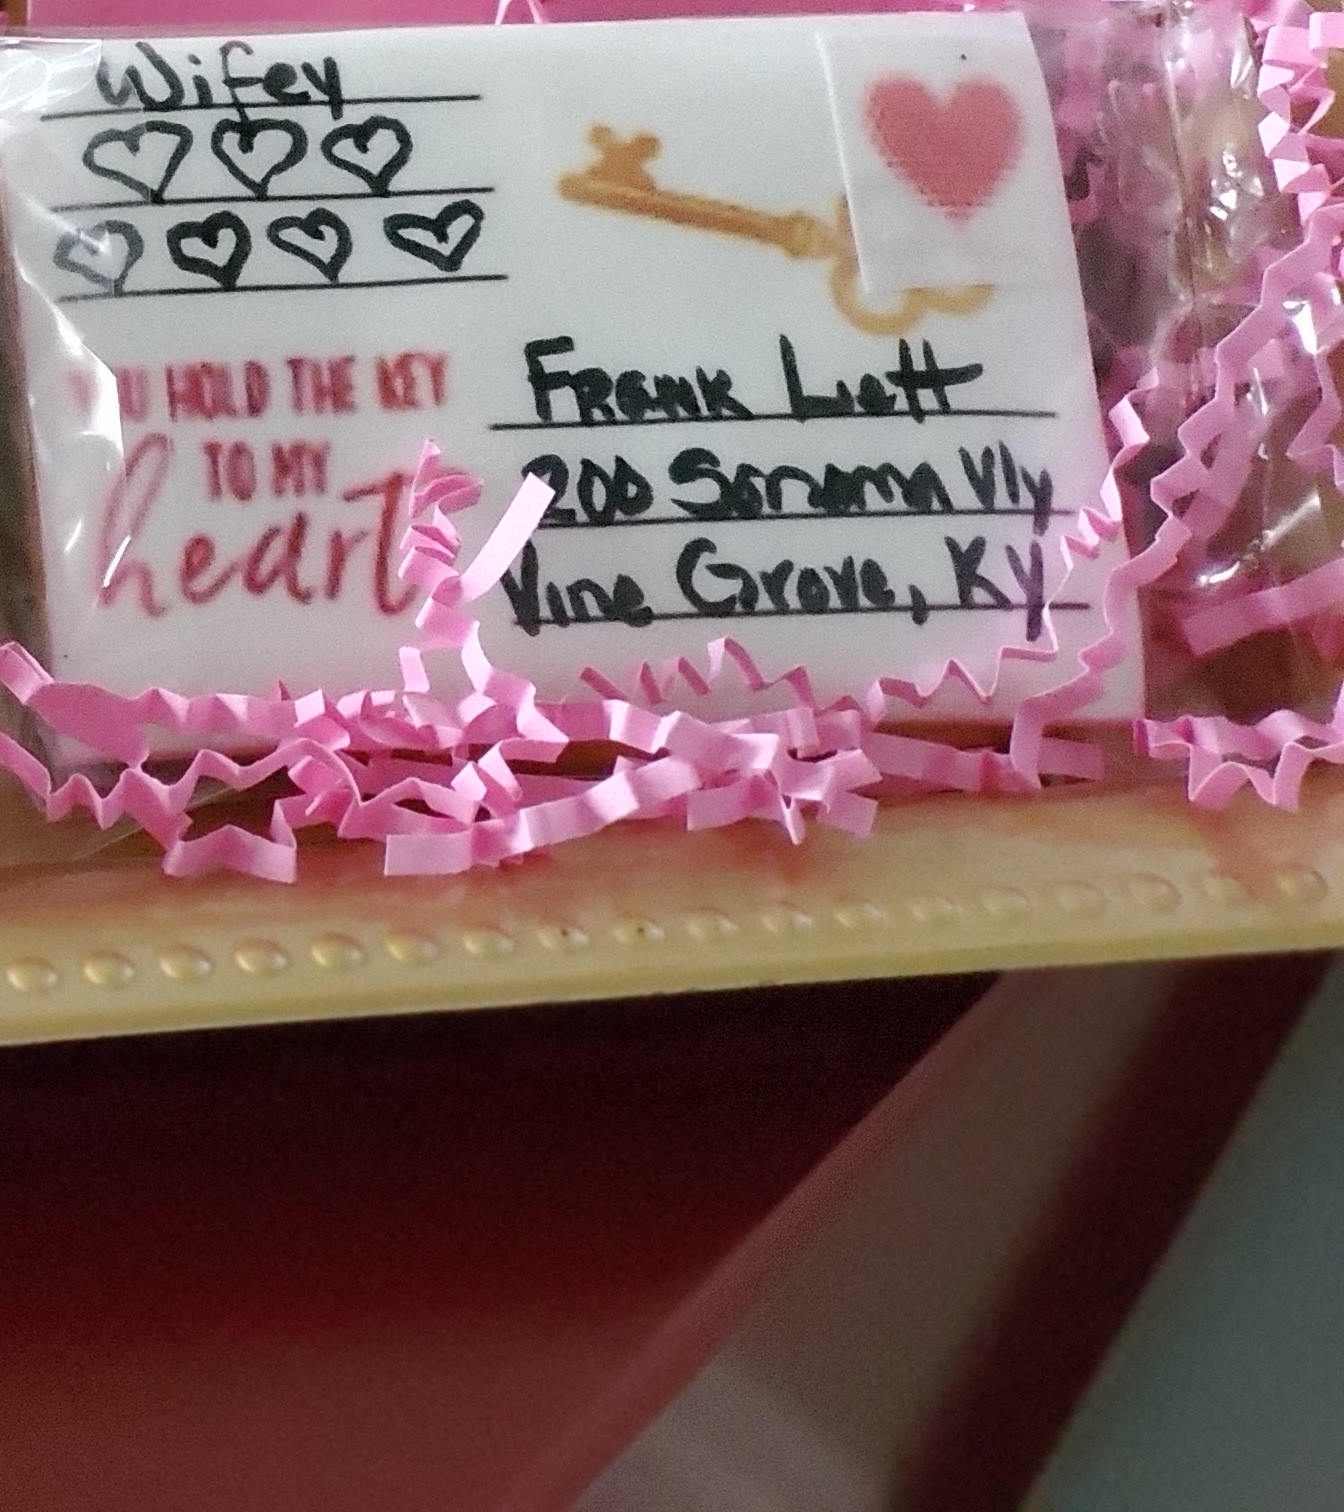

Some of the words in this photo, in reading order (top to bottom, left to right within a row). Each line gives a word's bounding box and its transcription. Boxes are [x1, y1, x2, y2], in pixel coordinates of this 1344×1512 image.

[96, 40, 346, 138] Wifey
[164, 359, 271, 422] HOLD
[286, 353, 360, 414] THE
[374, 349, 450, 412] KEY
[201, 439, 259, 503] TO
[270, 438, 332, 498] MY
[521, 452, 655, 526] 200
[958, 440, 1054, 537] Vly
[94, 432, 420, 619] heart
[498, 540, 655, 637] Vine
[943, 534, 1046, 642] KY
